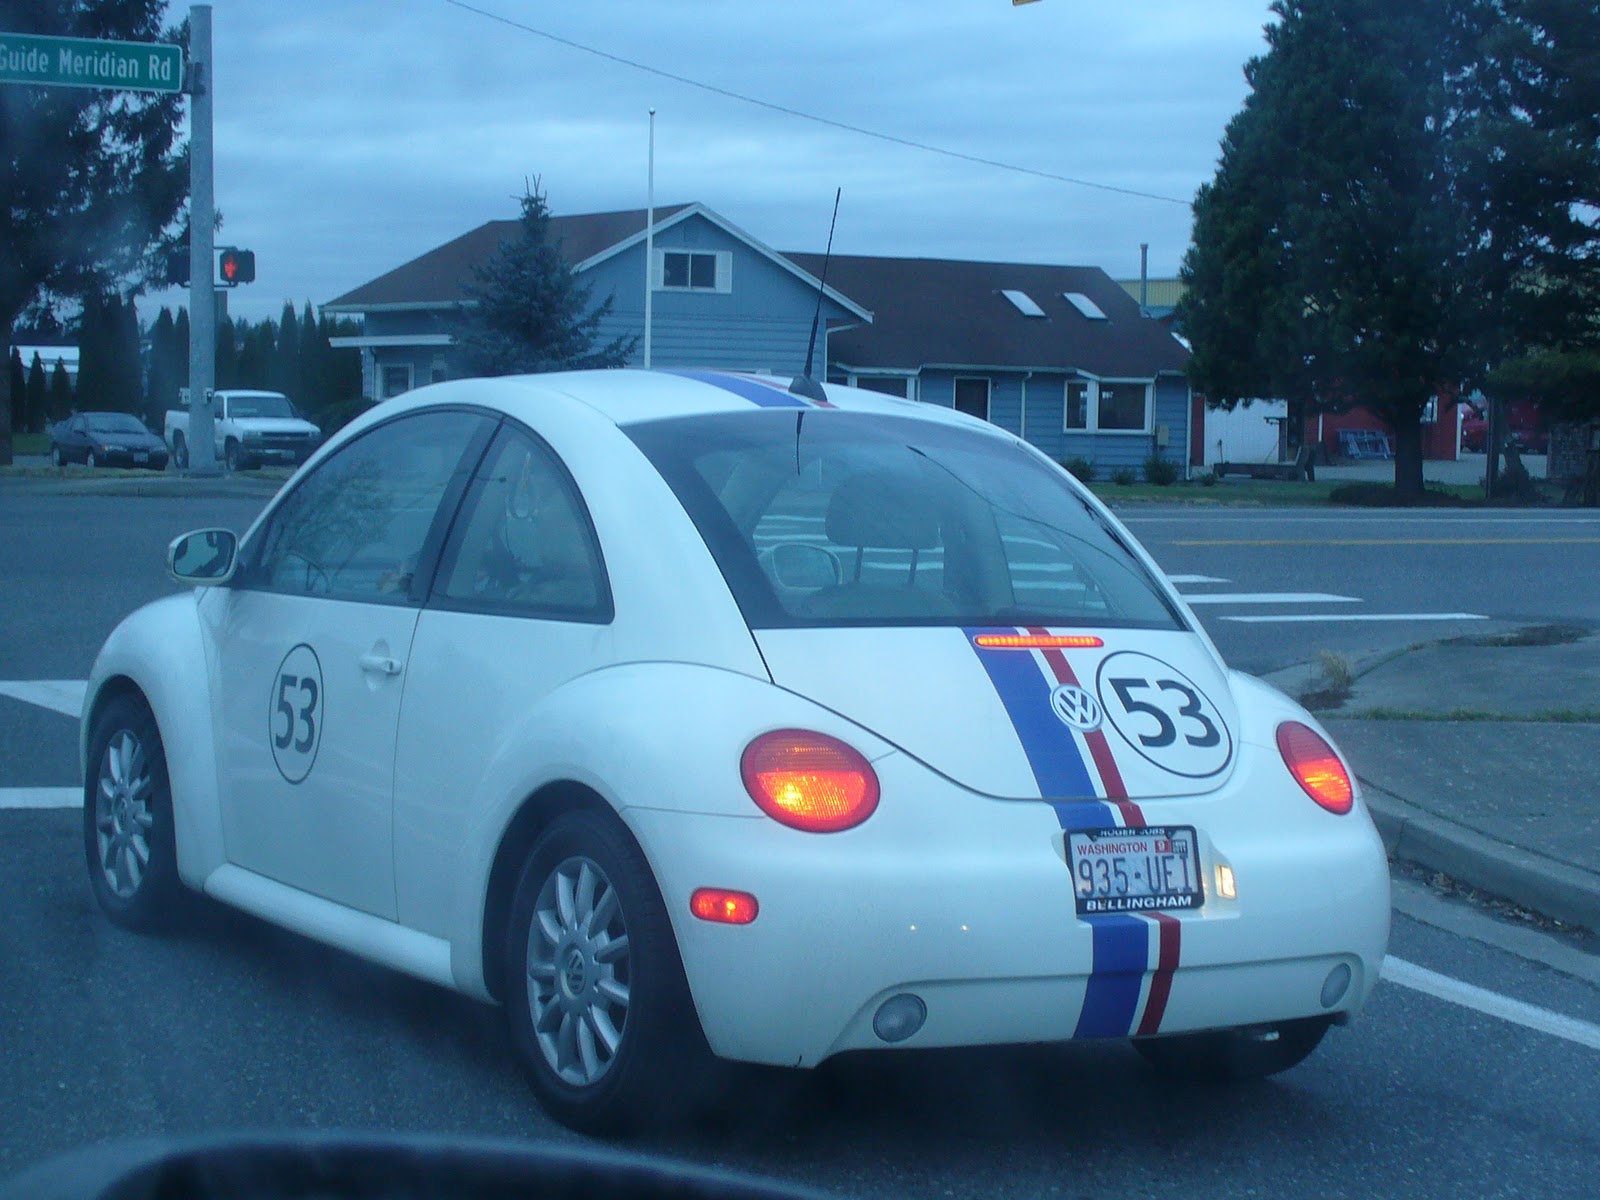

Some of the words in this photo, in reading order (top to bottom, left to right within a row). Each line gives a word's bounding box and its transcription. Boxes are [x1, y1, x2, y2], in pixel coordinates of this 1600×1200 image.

[0, 44, 49, 73] Guide
[59, 48, 139, 79] Meridian
[149, 54, 171, 81] Rd
[275, 673, 318, 754] 53
[1108, 678, 1221, 748] 53
[1077, 842, 1148, 856] WASHINGTON
[1087, 896, 1192, 910] BELLINGHAM
